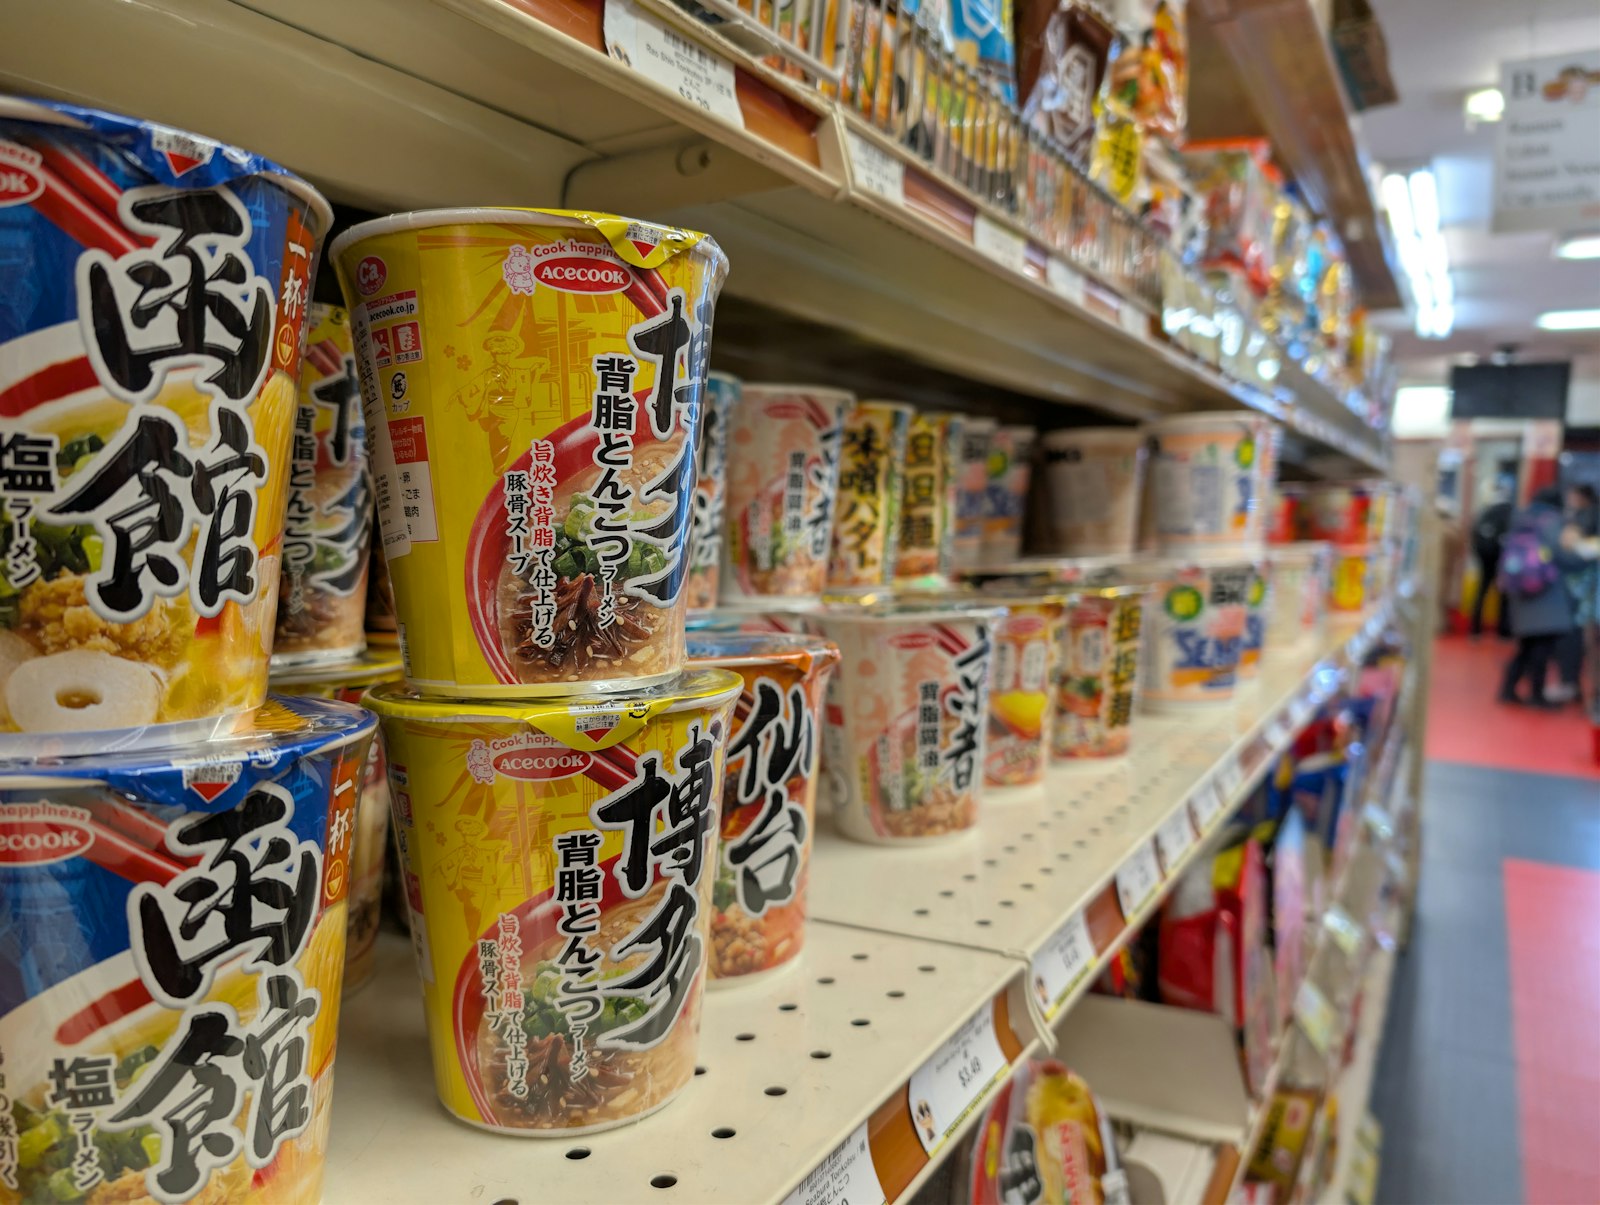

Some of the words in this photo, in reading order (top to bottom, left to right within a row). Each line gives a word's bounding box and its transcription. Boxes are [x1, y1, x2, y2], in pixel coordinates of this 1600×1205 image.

[533, 242, 566, 258] Cook
[506, 473, 530, 571] 豚骨スープ
[492, 735, 522, 751] Cook
[597, 723, 723, 1046] 博多
[107, 788, 319, 1194] 函館
[480, 942, 503, 1030] 豚骨スープ
